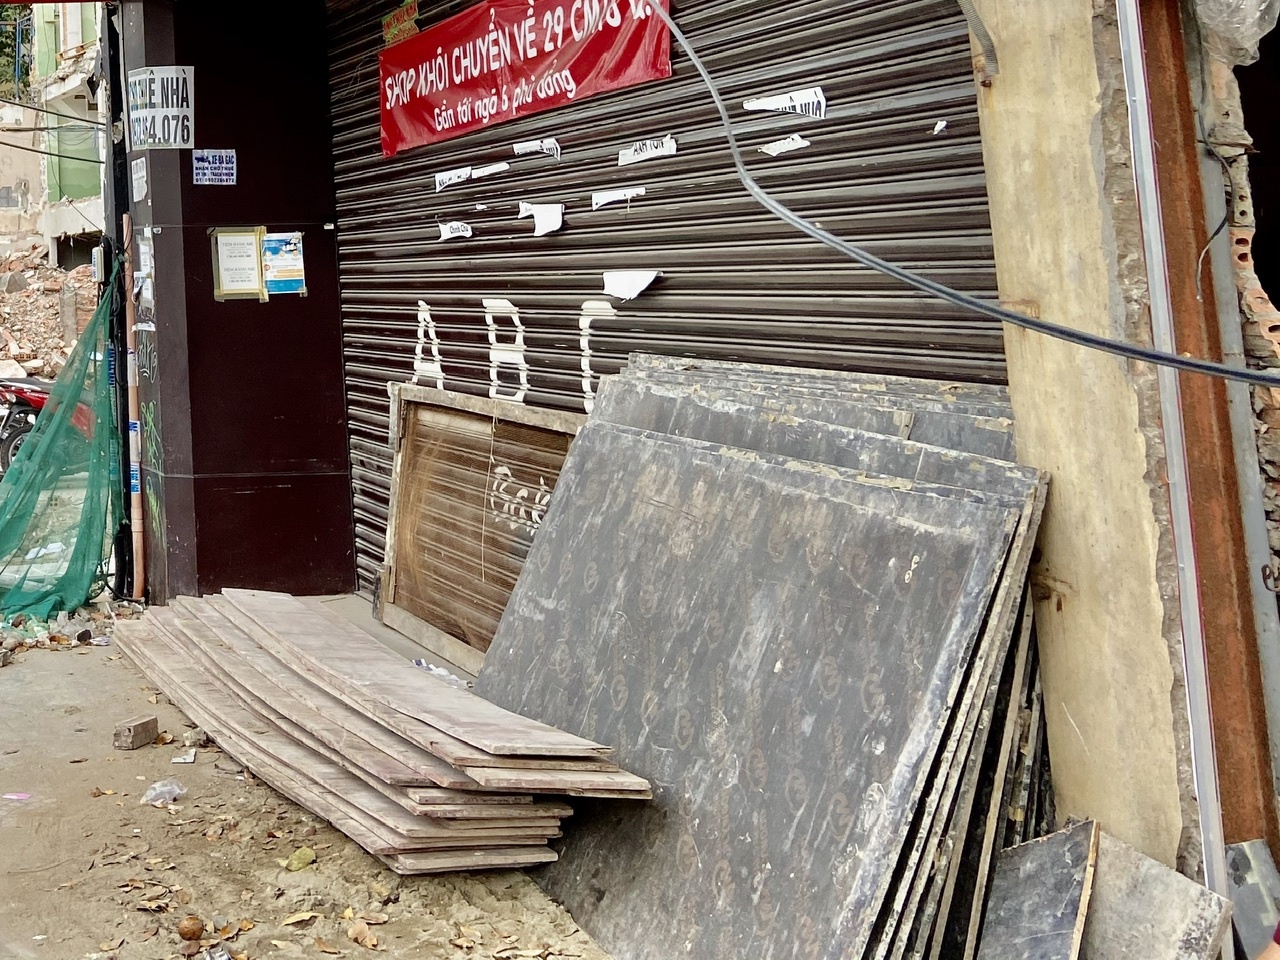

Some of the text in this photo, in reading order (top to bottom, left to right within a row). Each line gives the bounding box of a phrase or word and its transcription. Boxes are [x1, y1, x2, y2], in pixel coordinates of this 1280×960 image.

[385, 68, 417, 111] SHOP
[416, 46, 449, 99] KHÔI
[452, 7, 512, 85] CHUYỂN
[542, 5, 565, 54] 29
[160, 68, 190, 109] NHÀ
[434, 98, 455, 133] Gần
[501, 85, 509, 112] 6
